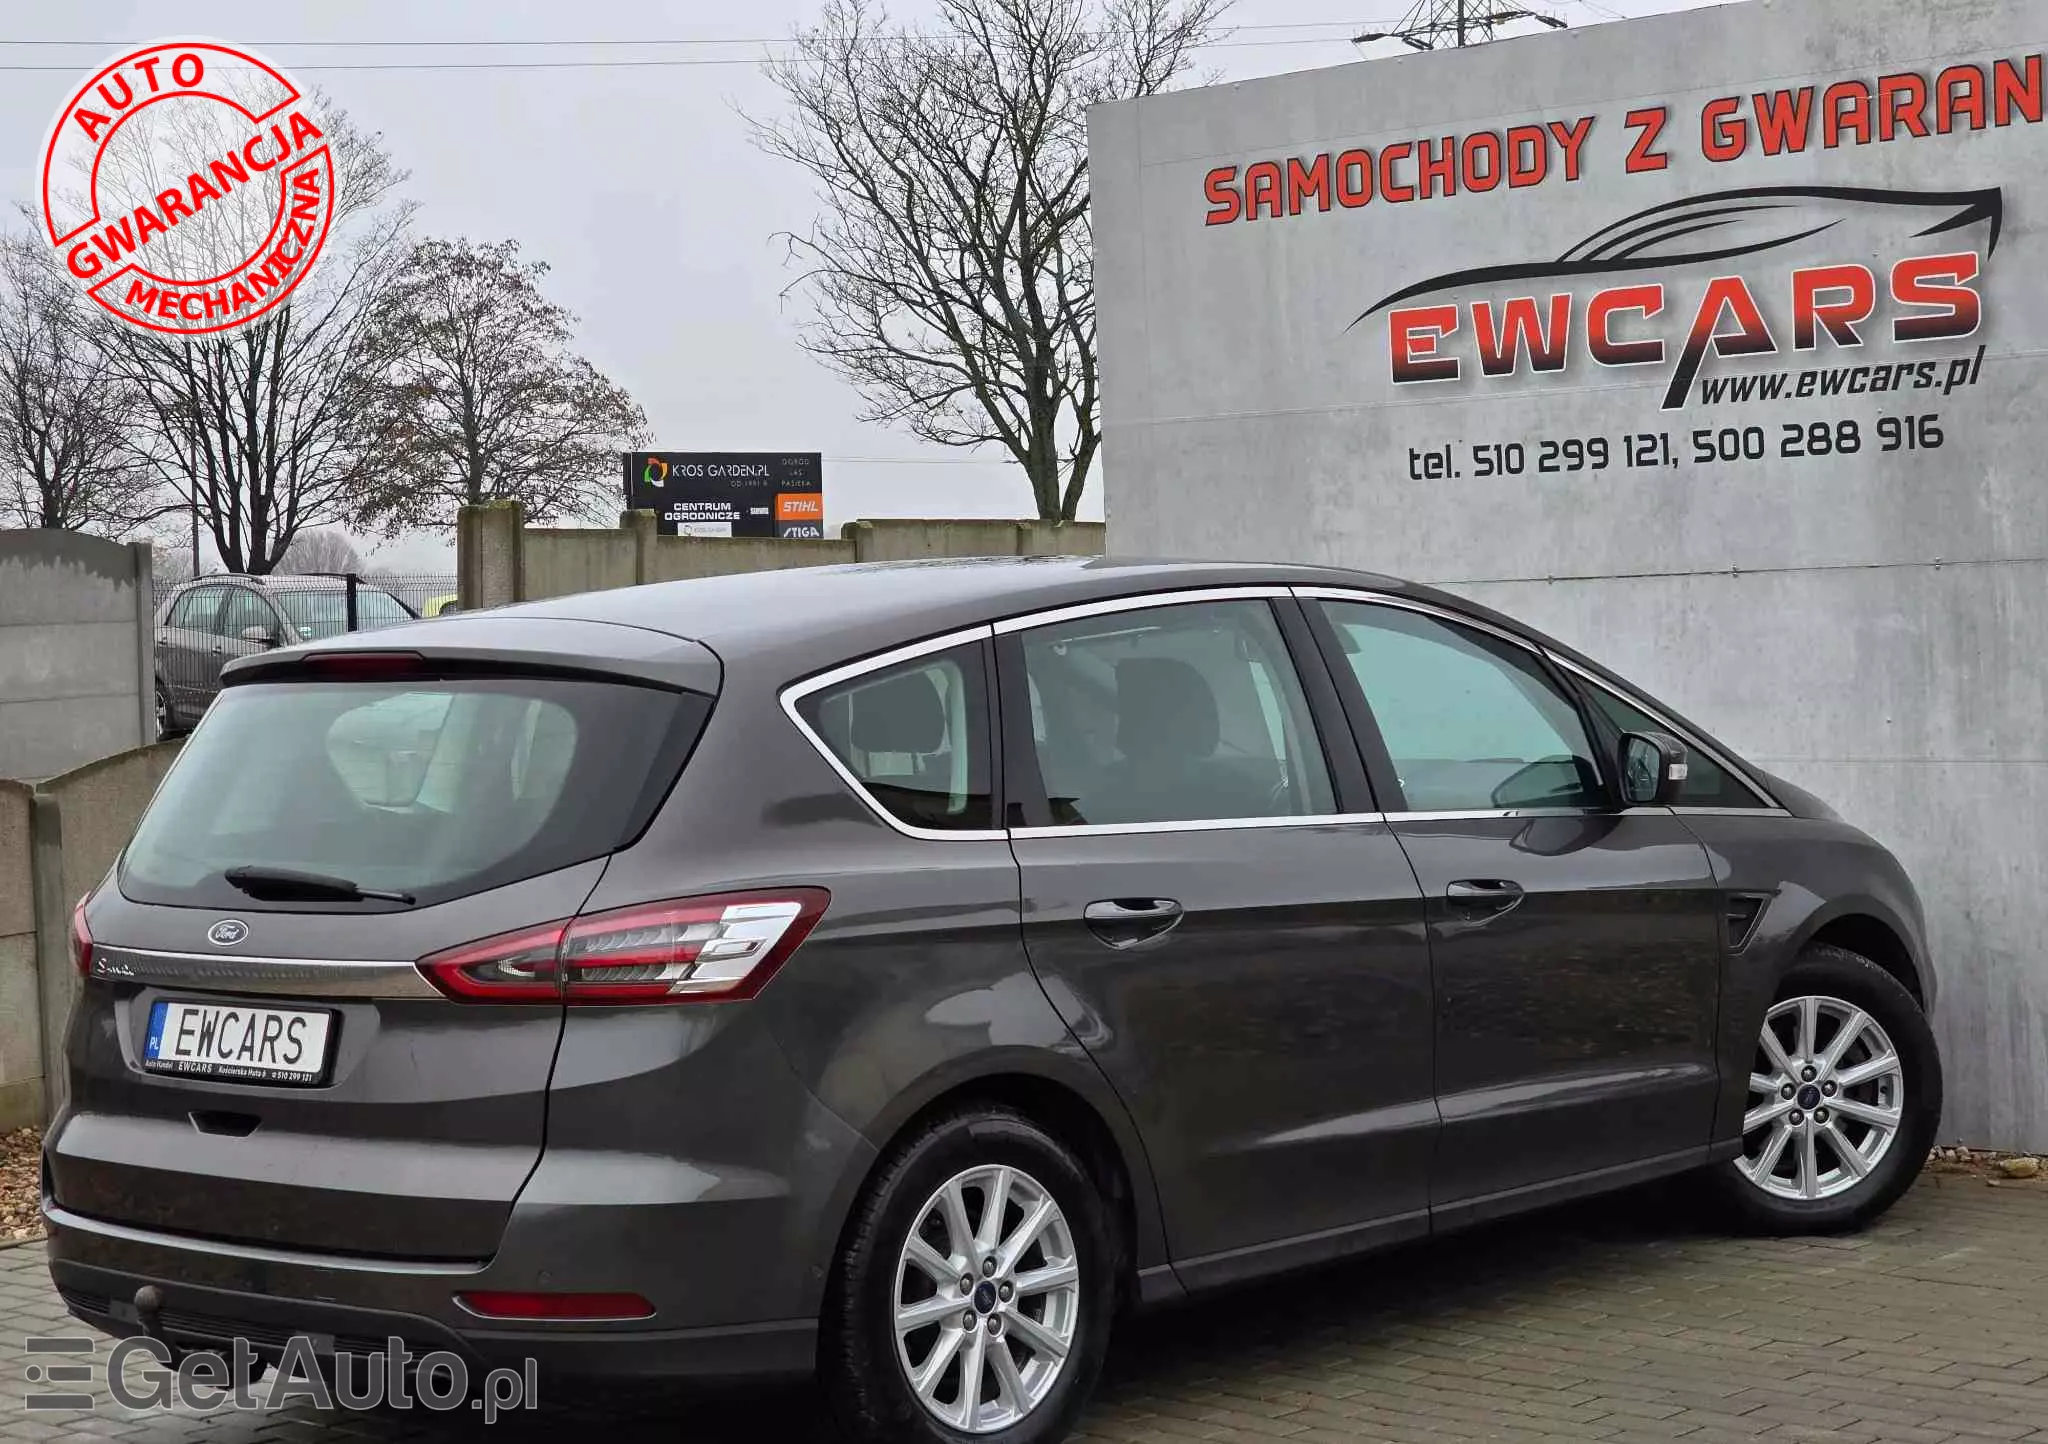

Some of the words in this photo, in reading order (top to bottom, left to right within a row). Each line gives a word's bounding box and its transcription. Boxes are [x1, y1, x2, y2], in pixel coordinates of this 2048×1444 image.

[1204, 116, 1595, 226] SAMOCHODY
[1624, 106, 1668, 174] Z
[1701, 54, 2044, 162] GWARAN
[1388, 252, 1982, 411] EWCARS
[1702, 345, 1986, 405] www.ewcars.pl
[1409, 443, 1461, 480] tel.
[1472, 443, 1525, 477] 510
[1538, 437, 1609, 472] 299
[1623, 432, 1679, 469] 121,
[1692, 426, 1764, 463] 500
[1780, 420, 1861, 458] 288
[1877, 414, 1944, 451] 916
[672, 464, 704, 477] KROS
[707, 464, 770, 477] GARDEN.PL
[673, 502, 732, 511] CENTRUM
[782, 501, 819, 513] STIHL
[664, 511, 741, 521] OGRODNICZE
[783, 527, 820, 538] STIGA
[215, 924, 240, 940] Ford
[174, 1008, 307, 1065] EWCARS
[149, 1037, 159, 1050] PL
[178, 1061, 213, 1073] EWCARS
